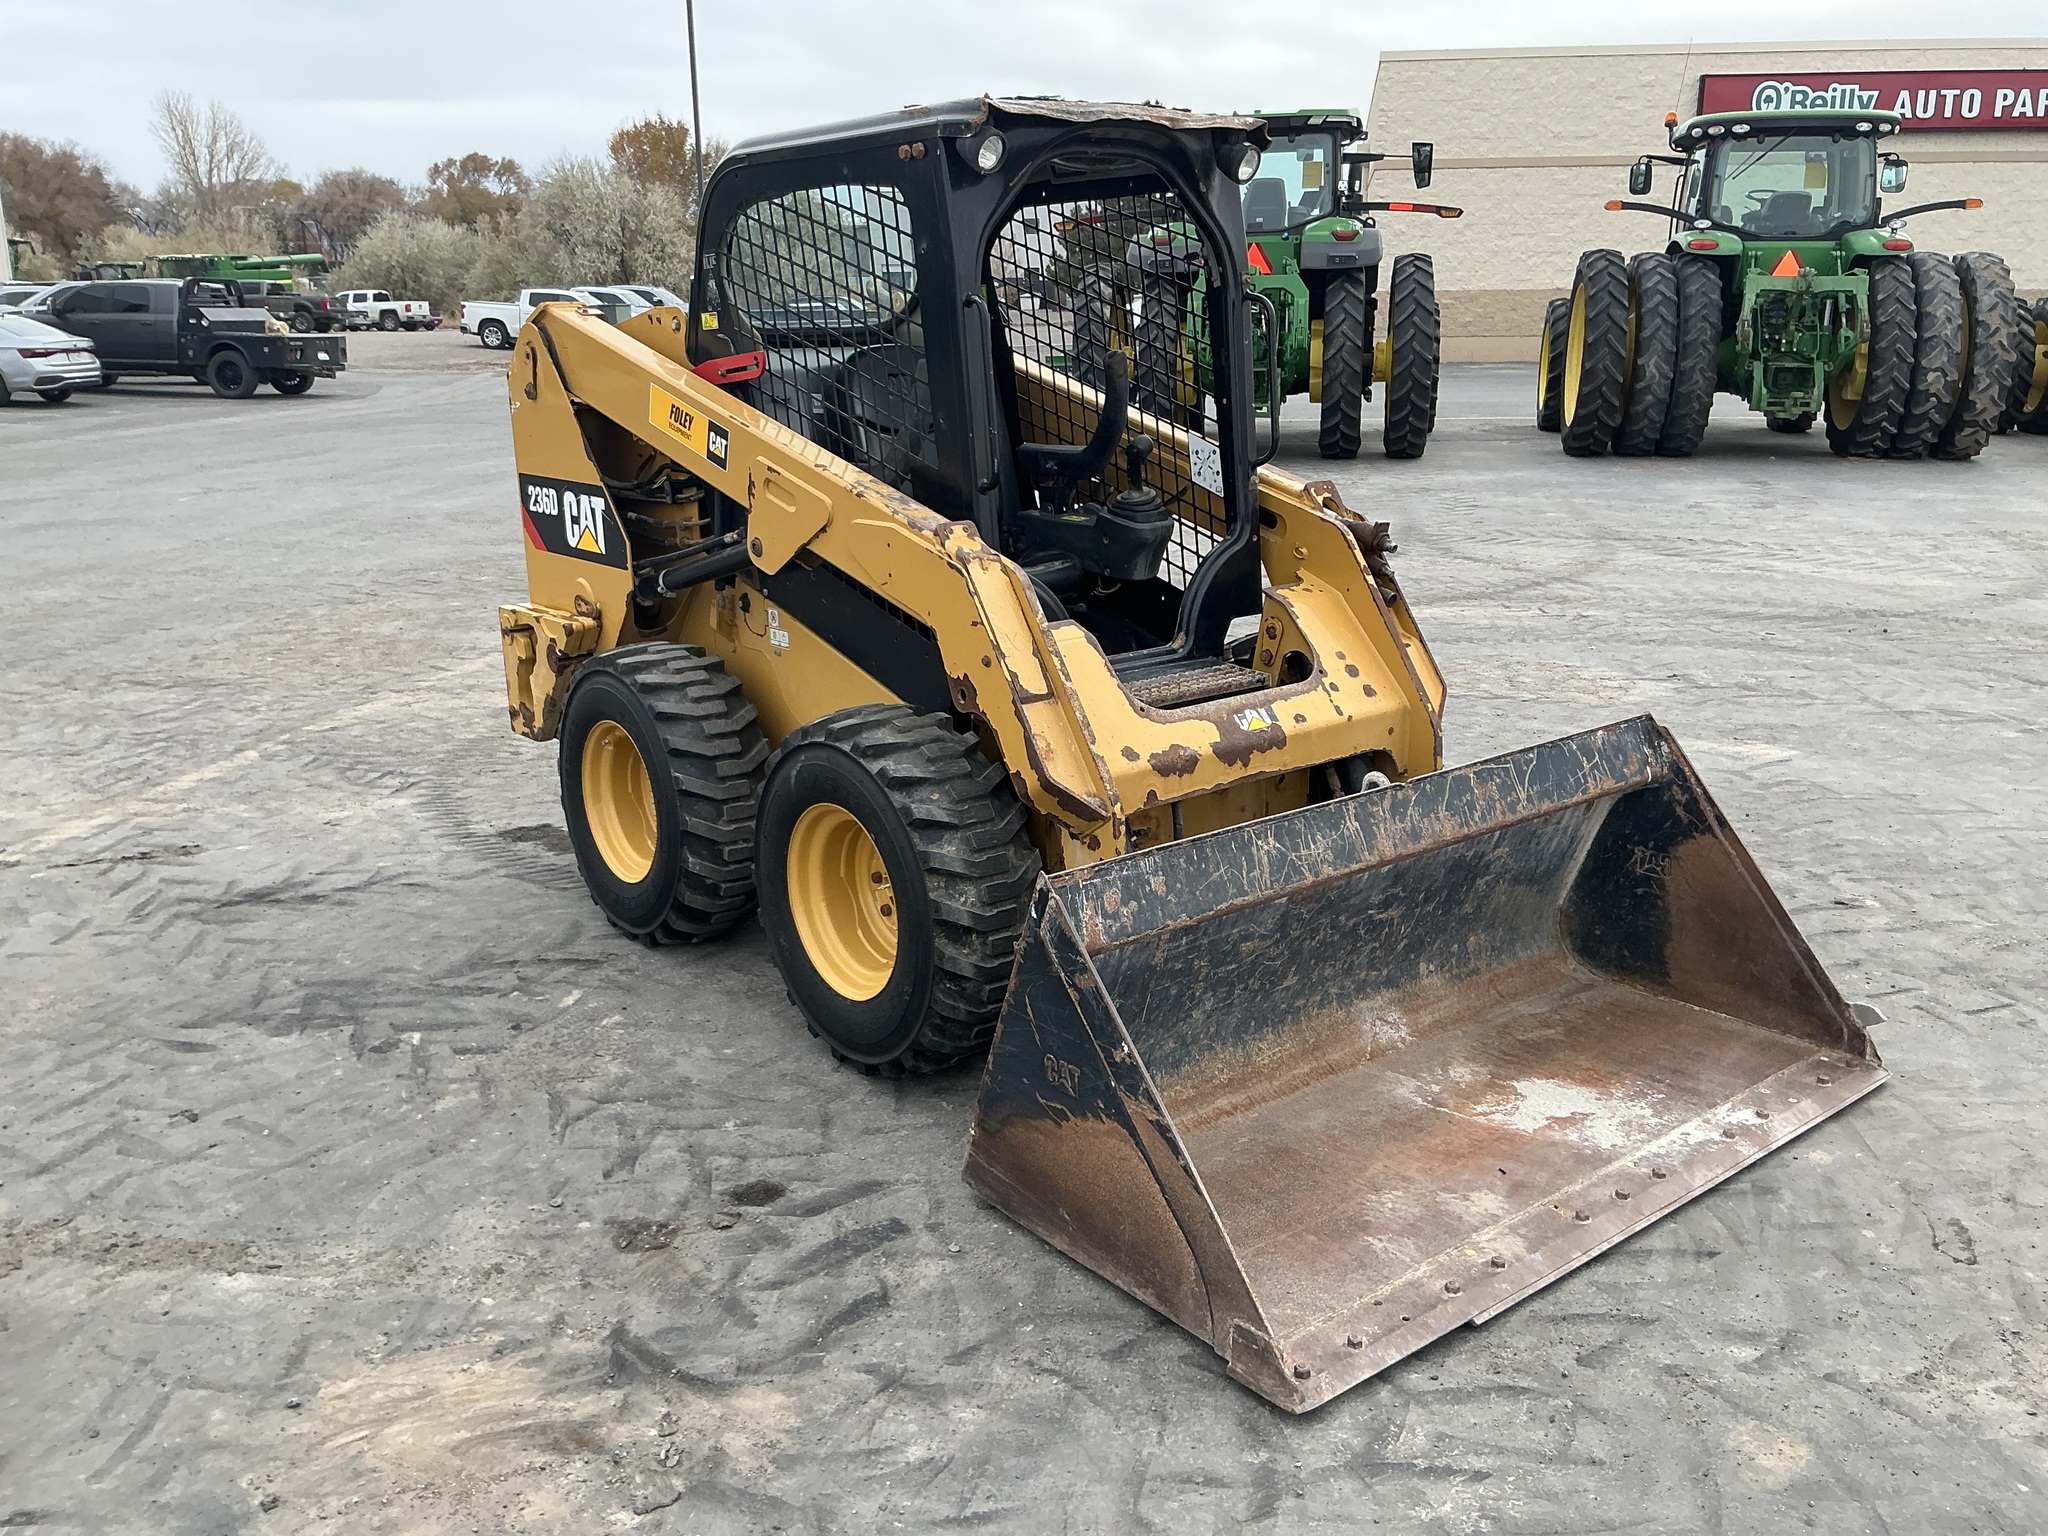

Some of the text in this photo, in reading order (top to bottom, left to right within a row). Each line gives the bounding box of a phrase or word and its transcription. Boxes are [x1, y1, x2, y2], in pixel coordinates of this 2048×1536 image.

[1754, 82, 1877, 111] O'Reilly
[1893, 88, 1983, 119] AUTO
[668, 421, 693, 442] EQUIPMENT
[669, 403, 695, 432] FOLEY
[709, 431, 728, 460] CAT
[528, 485, 559, 516] 236D
[563, 490, 606, 555] CAT
[1043, 1053, 1081, 1100] CAT
